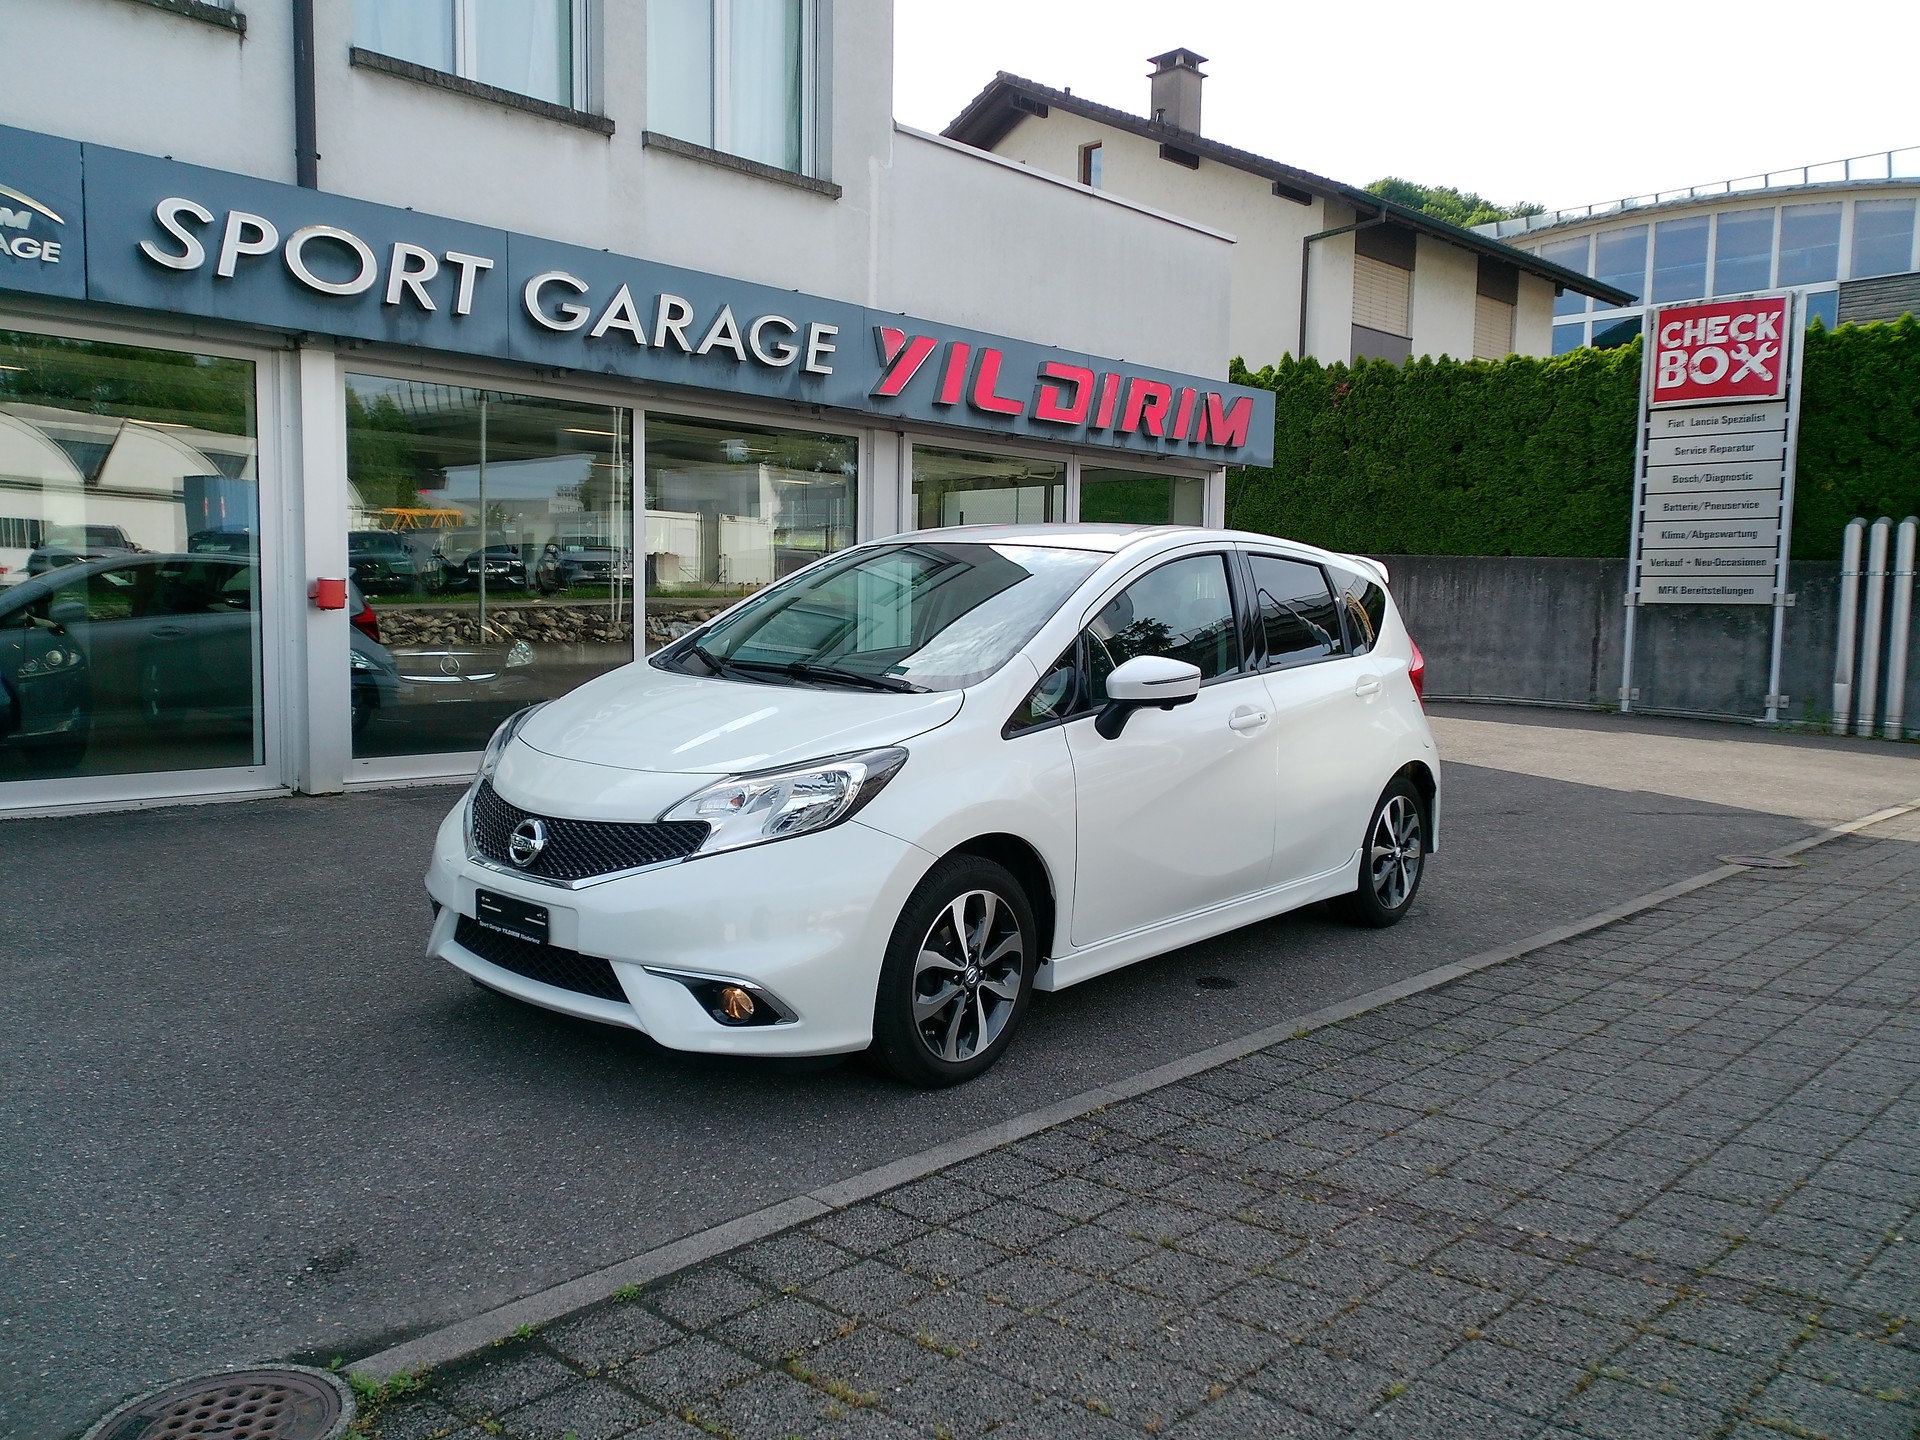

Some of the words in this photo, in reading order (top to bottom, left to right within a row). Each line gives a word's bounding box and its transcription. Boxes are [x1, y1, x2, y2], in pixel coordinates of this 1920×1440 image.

[138, 197, 494, 316] SPORT
[524, 271, 838, 375] GARAGE
[869, 325, 1254, 448] YILDIRIM
[1660, 311, 1782, 348] CHECK
[1658, 342, 1779, 388] BOX
[1668, 418, 1685, 428] Fiat
[1690, 416, 1720, 427] Lancia
[1721, 413, 1766, 425] Spezialist
[1674, 446, 1707, 456] Service
[1709, 444, 1755, 455] Reparatur
[1672, 472, 1754, 483] Bosch/Diagnostic
[1663, 500, 1759, 512] Batterie/Pneuservice
[1661, 530, 1758, 541] Klima/Abgaswartung
[1650, 558, 1684, 567] Verkauf
[1695, 557, 1767, 567] Neu-Occasionen
[1658, 586, 1679, 595] MFK
[1680, 585, 1754, 596] Bereitstellungen
